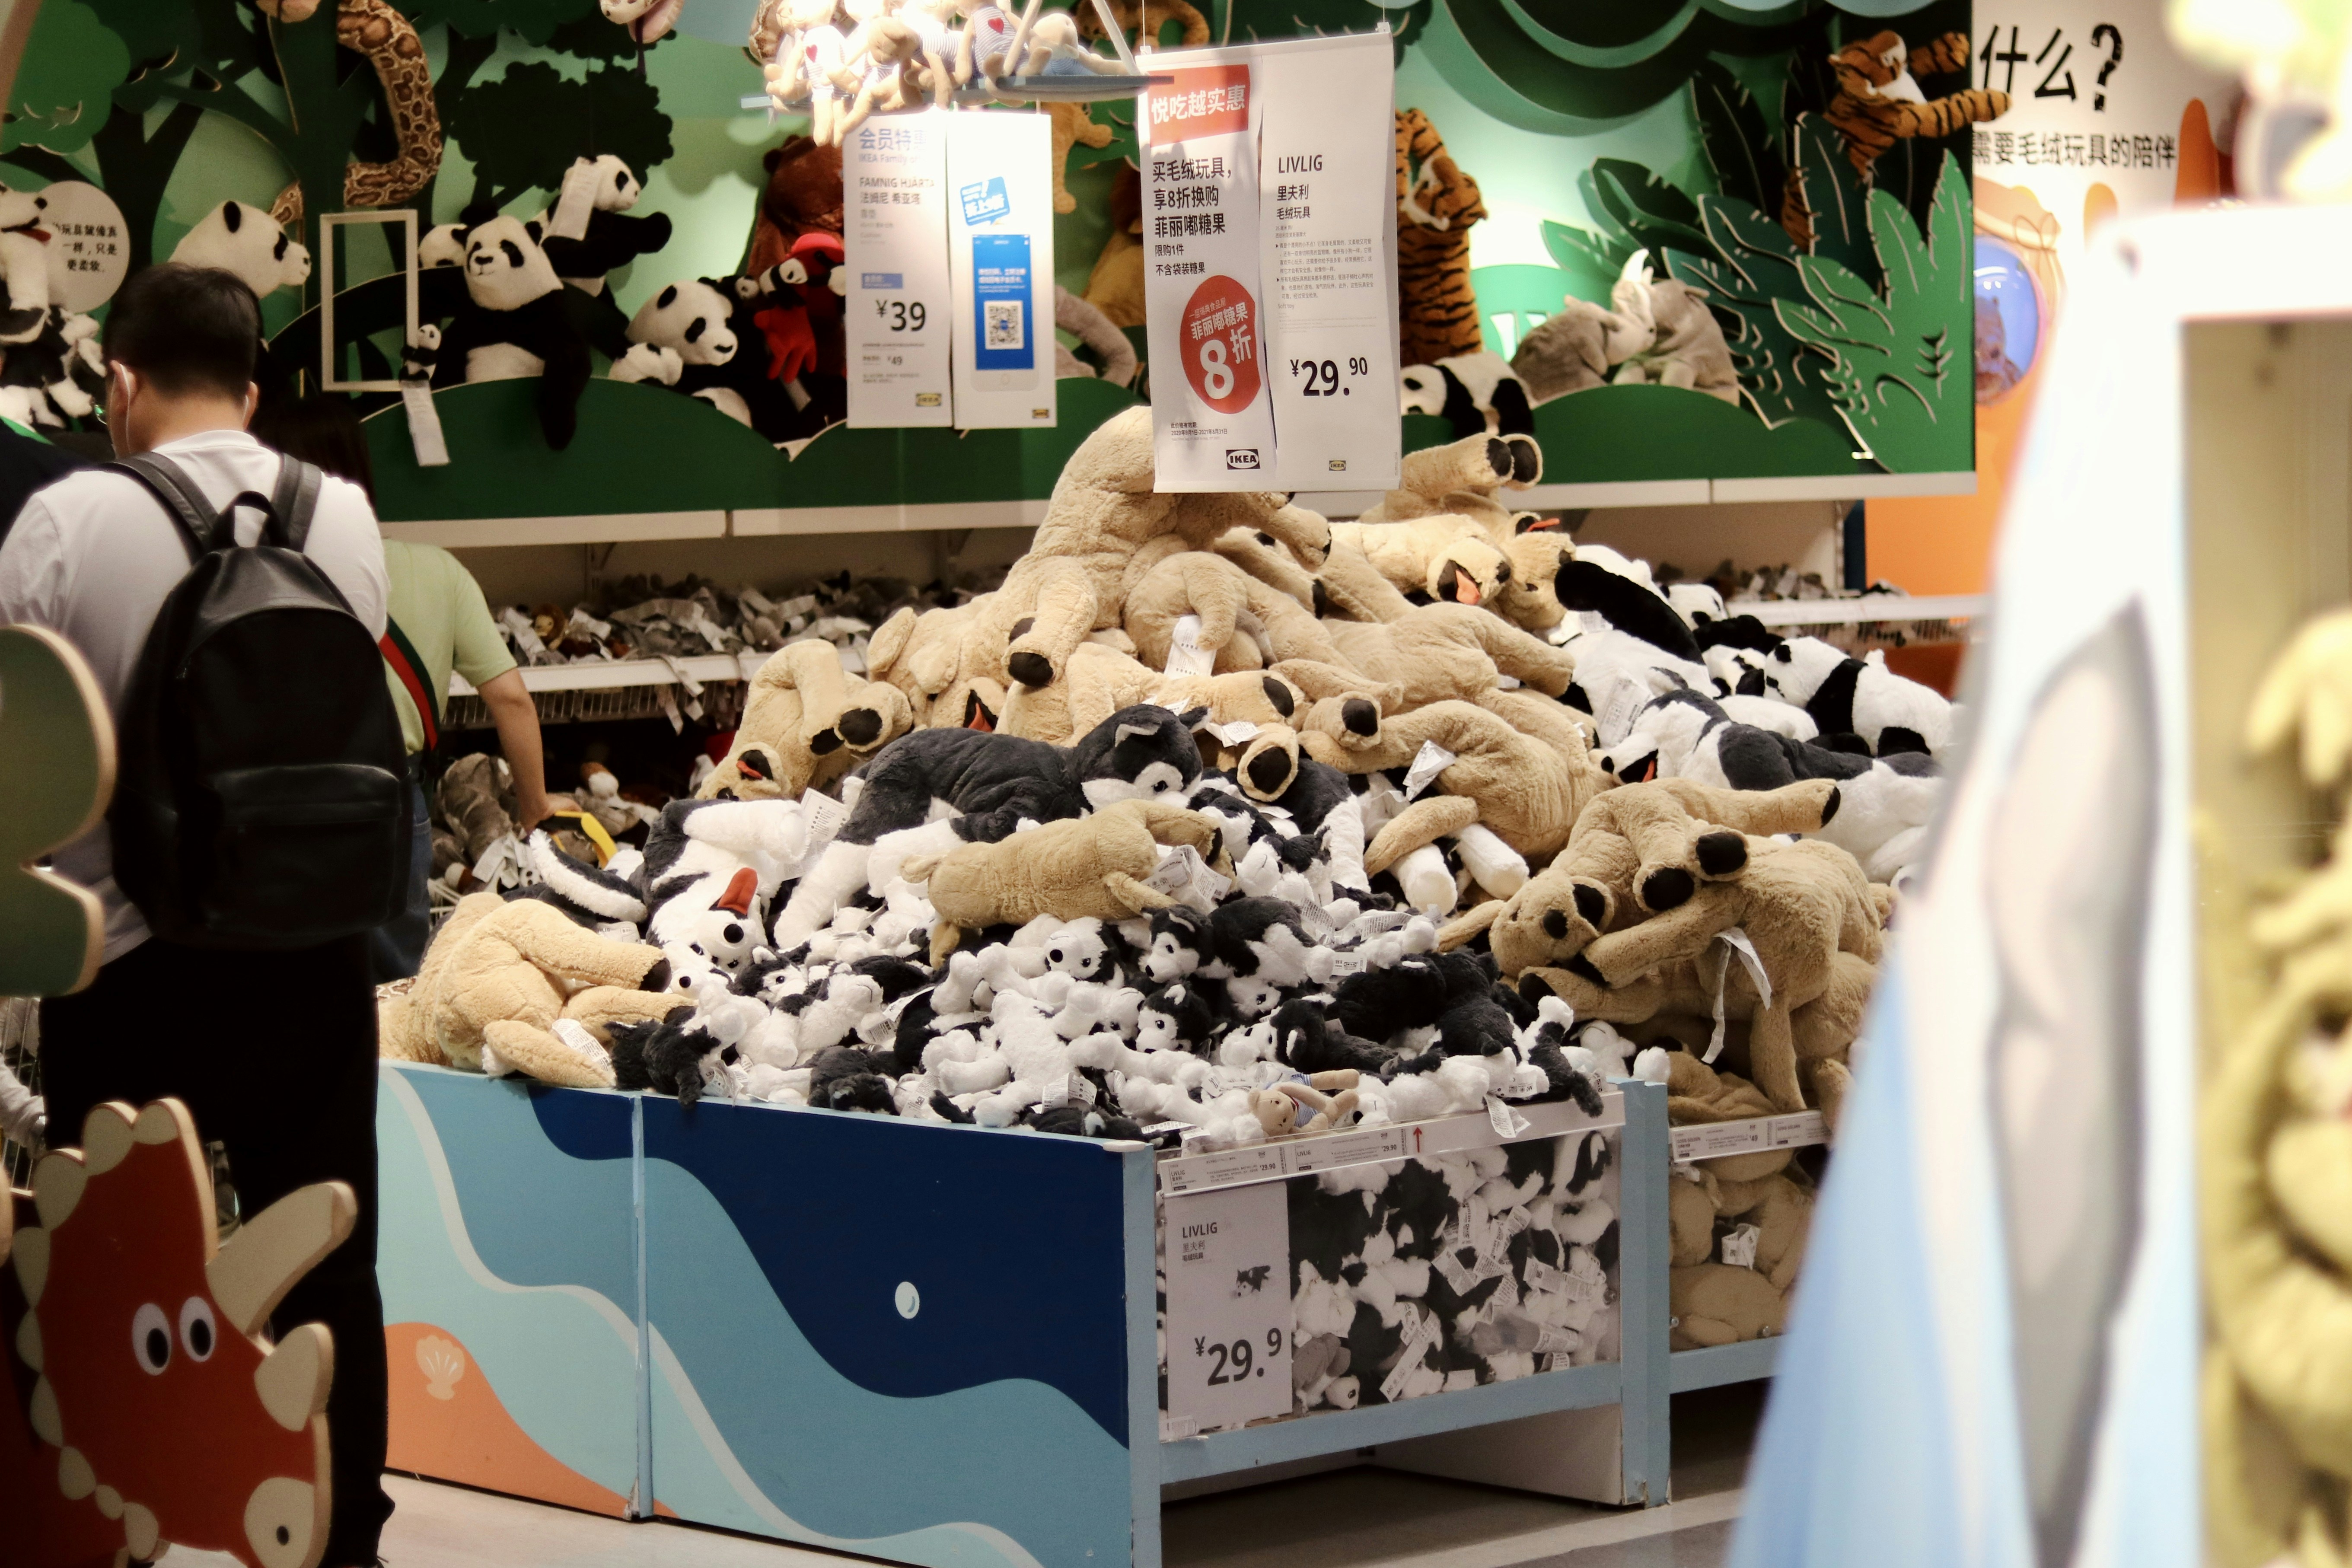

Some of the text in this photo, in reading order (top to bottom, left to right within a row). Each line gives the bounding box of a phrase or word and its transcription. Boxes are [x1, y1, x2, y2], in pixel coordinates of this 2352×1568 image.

[1979, 22, 2123, 112] 什么？
[1151, 84, 1246, 124] 悦吃越实惠
[859, 127, 927, 150] 会员特惠
[1973, 131, 2176, 169] 需要毛绒玩具的陪伴
[1153, 157, 1232, 183] 买毛绒玩具，
[1278, 154, 1323, 174] LIVLIG
[860, 177, 898, 188] FAMNIG
[1277, 184, 1309, 201] 里夫利
[1154, 185, 1219, 210] 享8折换购
[1276, 206, 1311, 220] 毛绒玩具
[1154, 213, 1226, 238] 菲丽嘟糖果
[1155, 244, 1184, 257] 限购1件
[1156, 262, 1205, 276] 不含袋装糖果
[876, 299, 926, 331] ¥39
[1190, 302, 1249, 341] 菲丽嘟糖果
[1200, 324, 1252, 400] 8折
[1230, 455, 1257, 463] IKEA
[1182, 1222, 1217, 1238] LIVLIG
[1182, 1240, 1205, 1253] 里夫利
